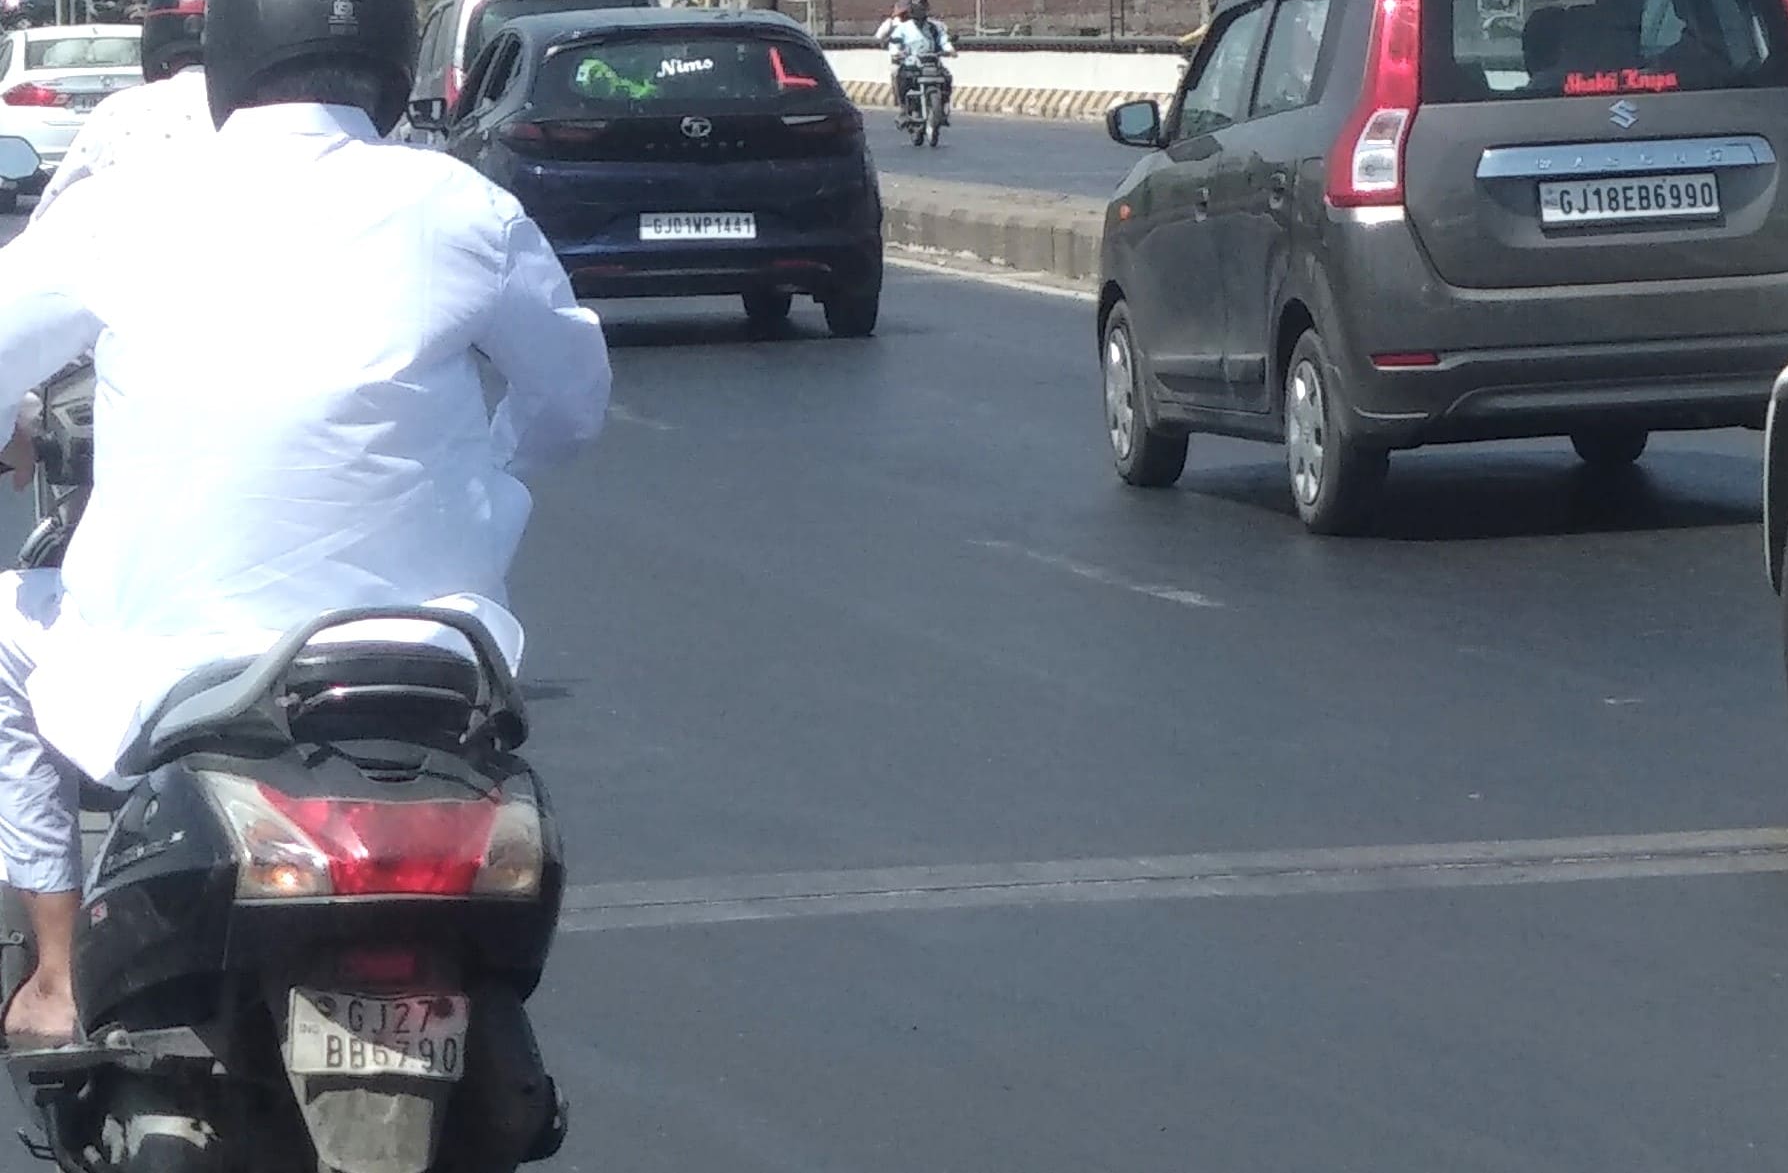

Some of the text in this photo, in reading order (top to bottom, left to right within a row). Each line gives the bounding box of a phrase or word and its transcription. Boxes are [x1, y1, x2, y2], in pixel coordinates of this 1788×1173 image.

[656, 57, 714, 78] Nims
[1559, 181, 1714, 215] GJ18EB6990
[653, 216, 752, 235] GJ01WP1441
[348, 999, 433, 1034] GJ27
